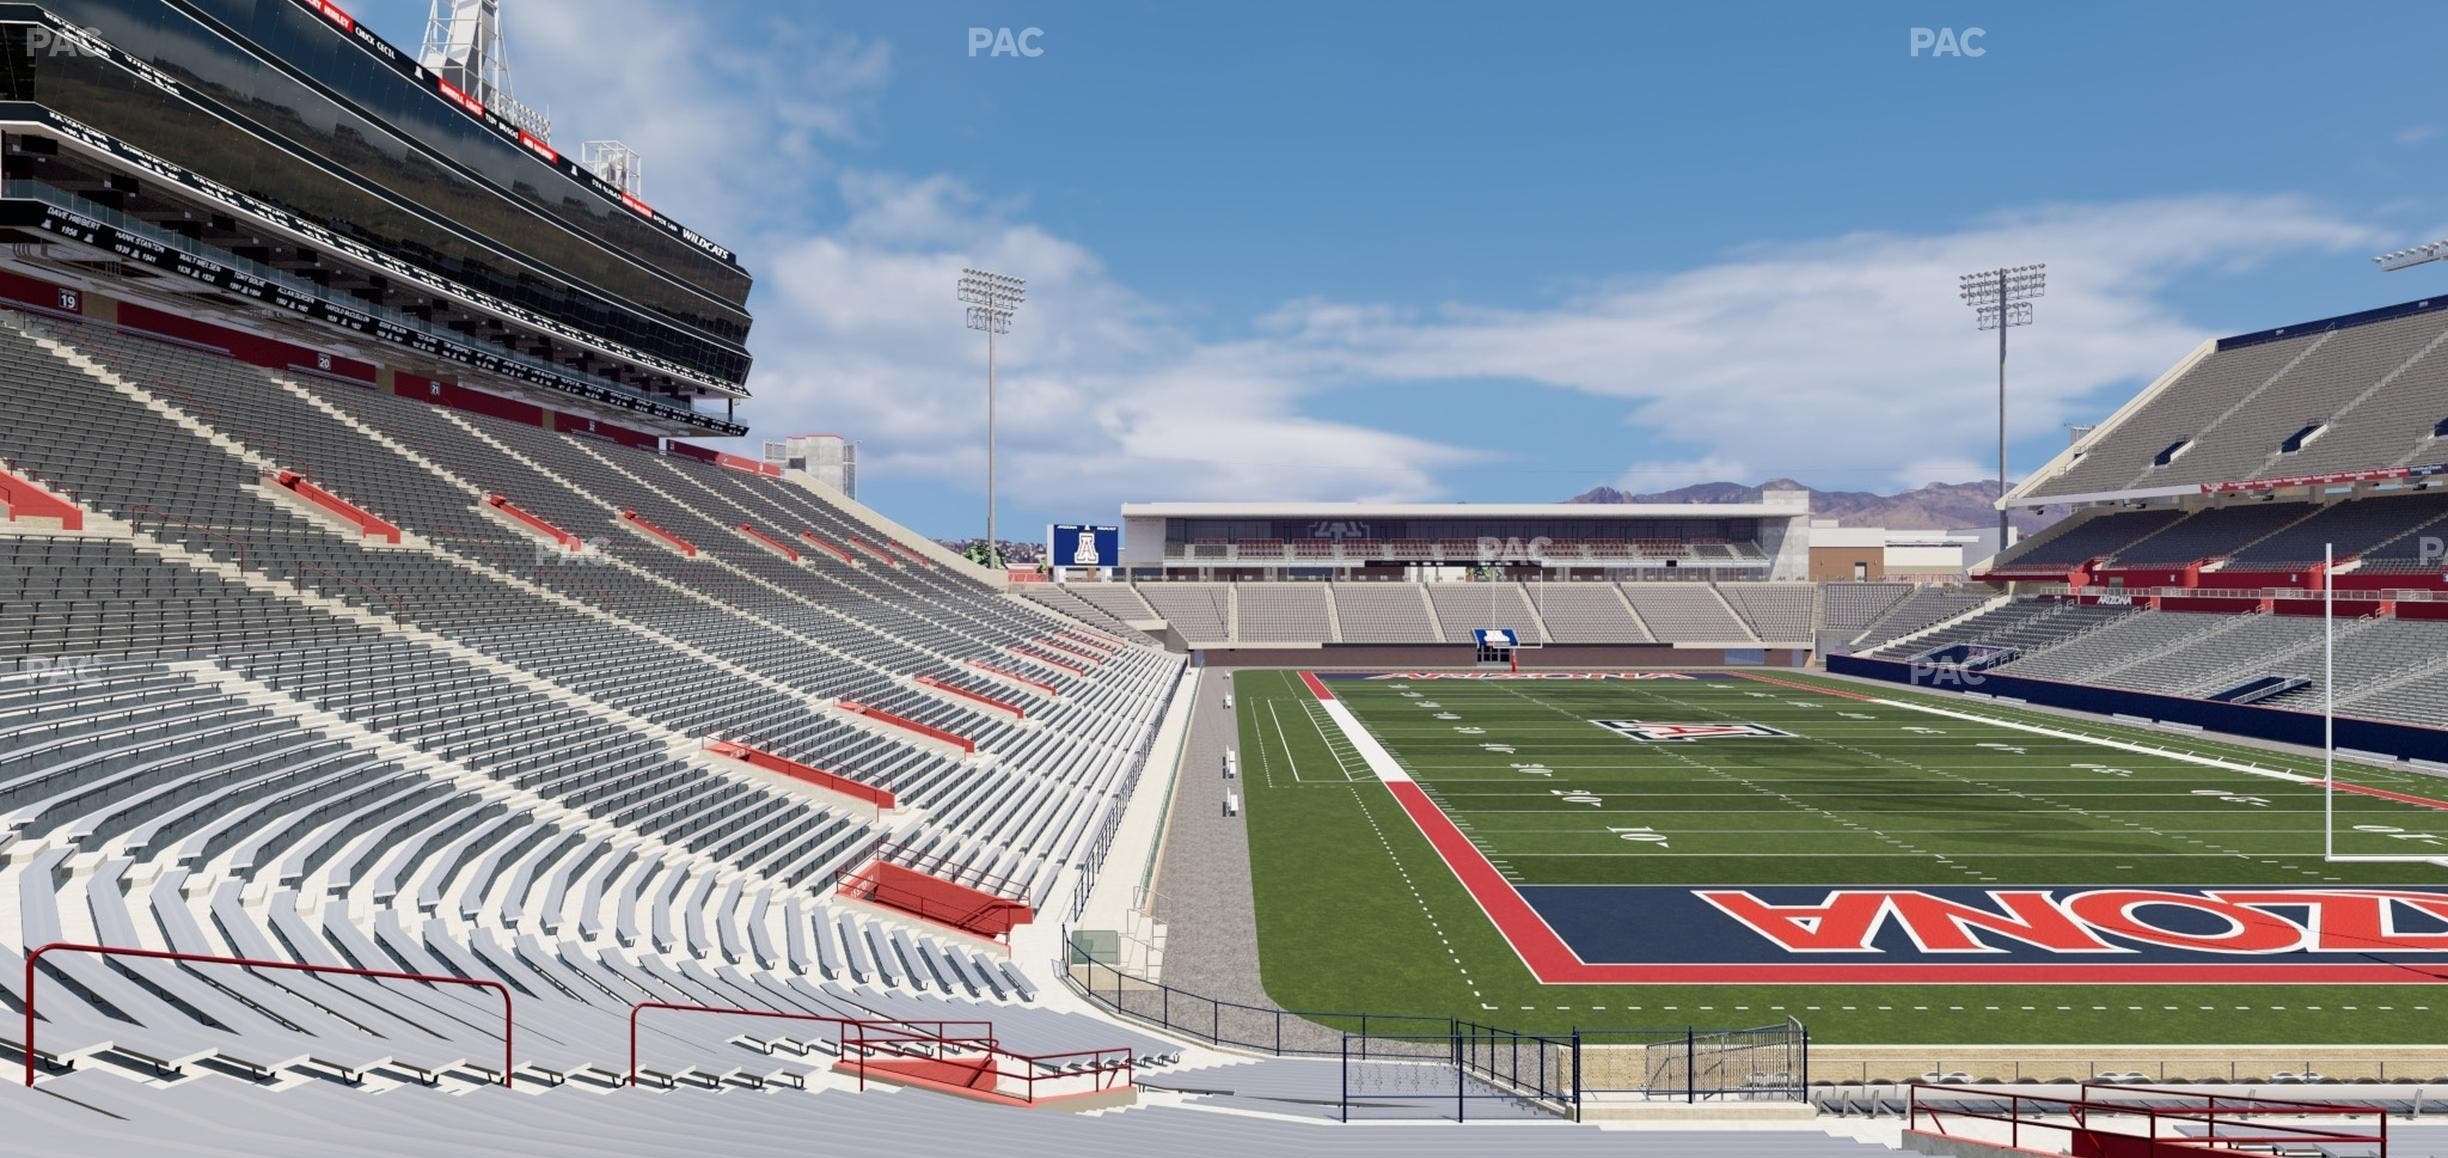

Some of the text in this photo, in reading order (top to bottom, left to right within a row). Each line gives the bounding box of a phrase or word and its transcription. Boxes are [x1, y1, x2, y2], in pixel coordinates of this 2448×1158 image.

[355, 26, 396, 60] CHUCK CECIL
[47, 206, 102, 231] DAVE HIBBERT
[115, 231, 134, 242] HANK
[682, 228, 729, 260] WILDCATS
[61, 294, 76, 308] 19
[319, 357, 330, 368] 20
[2097, 594, 2132, 605] ARIZONA
[1550, 789, 1602, 803] 20
[1606, 826, 1668, 842] 10
[1689, 889, 2448, 954] ZONA
